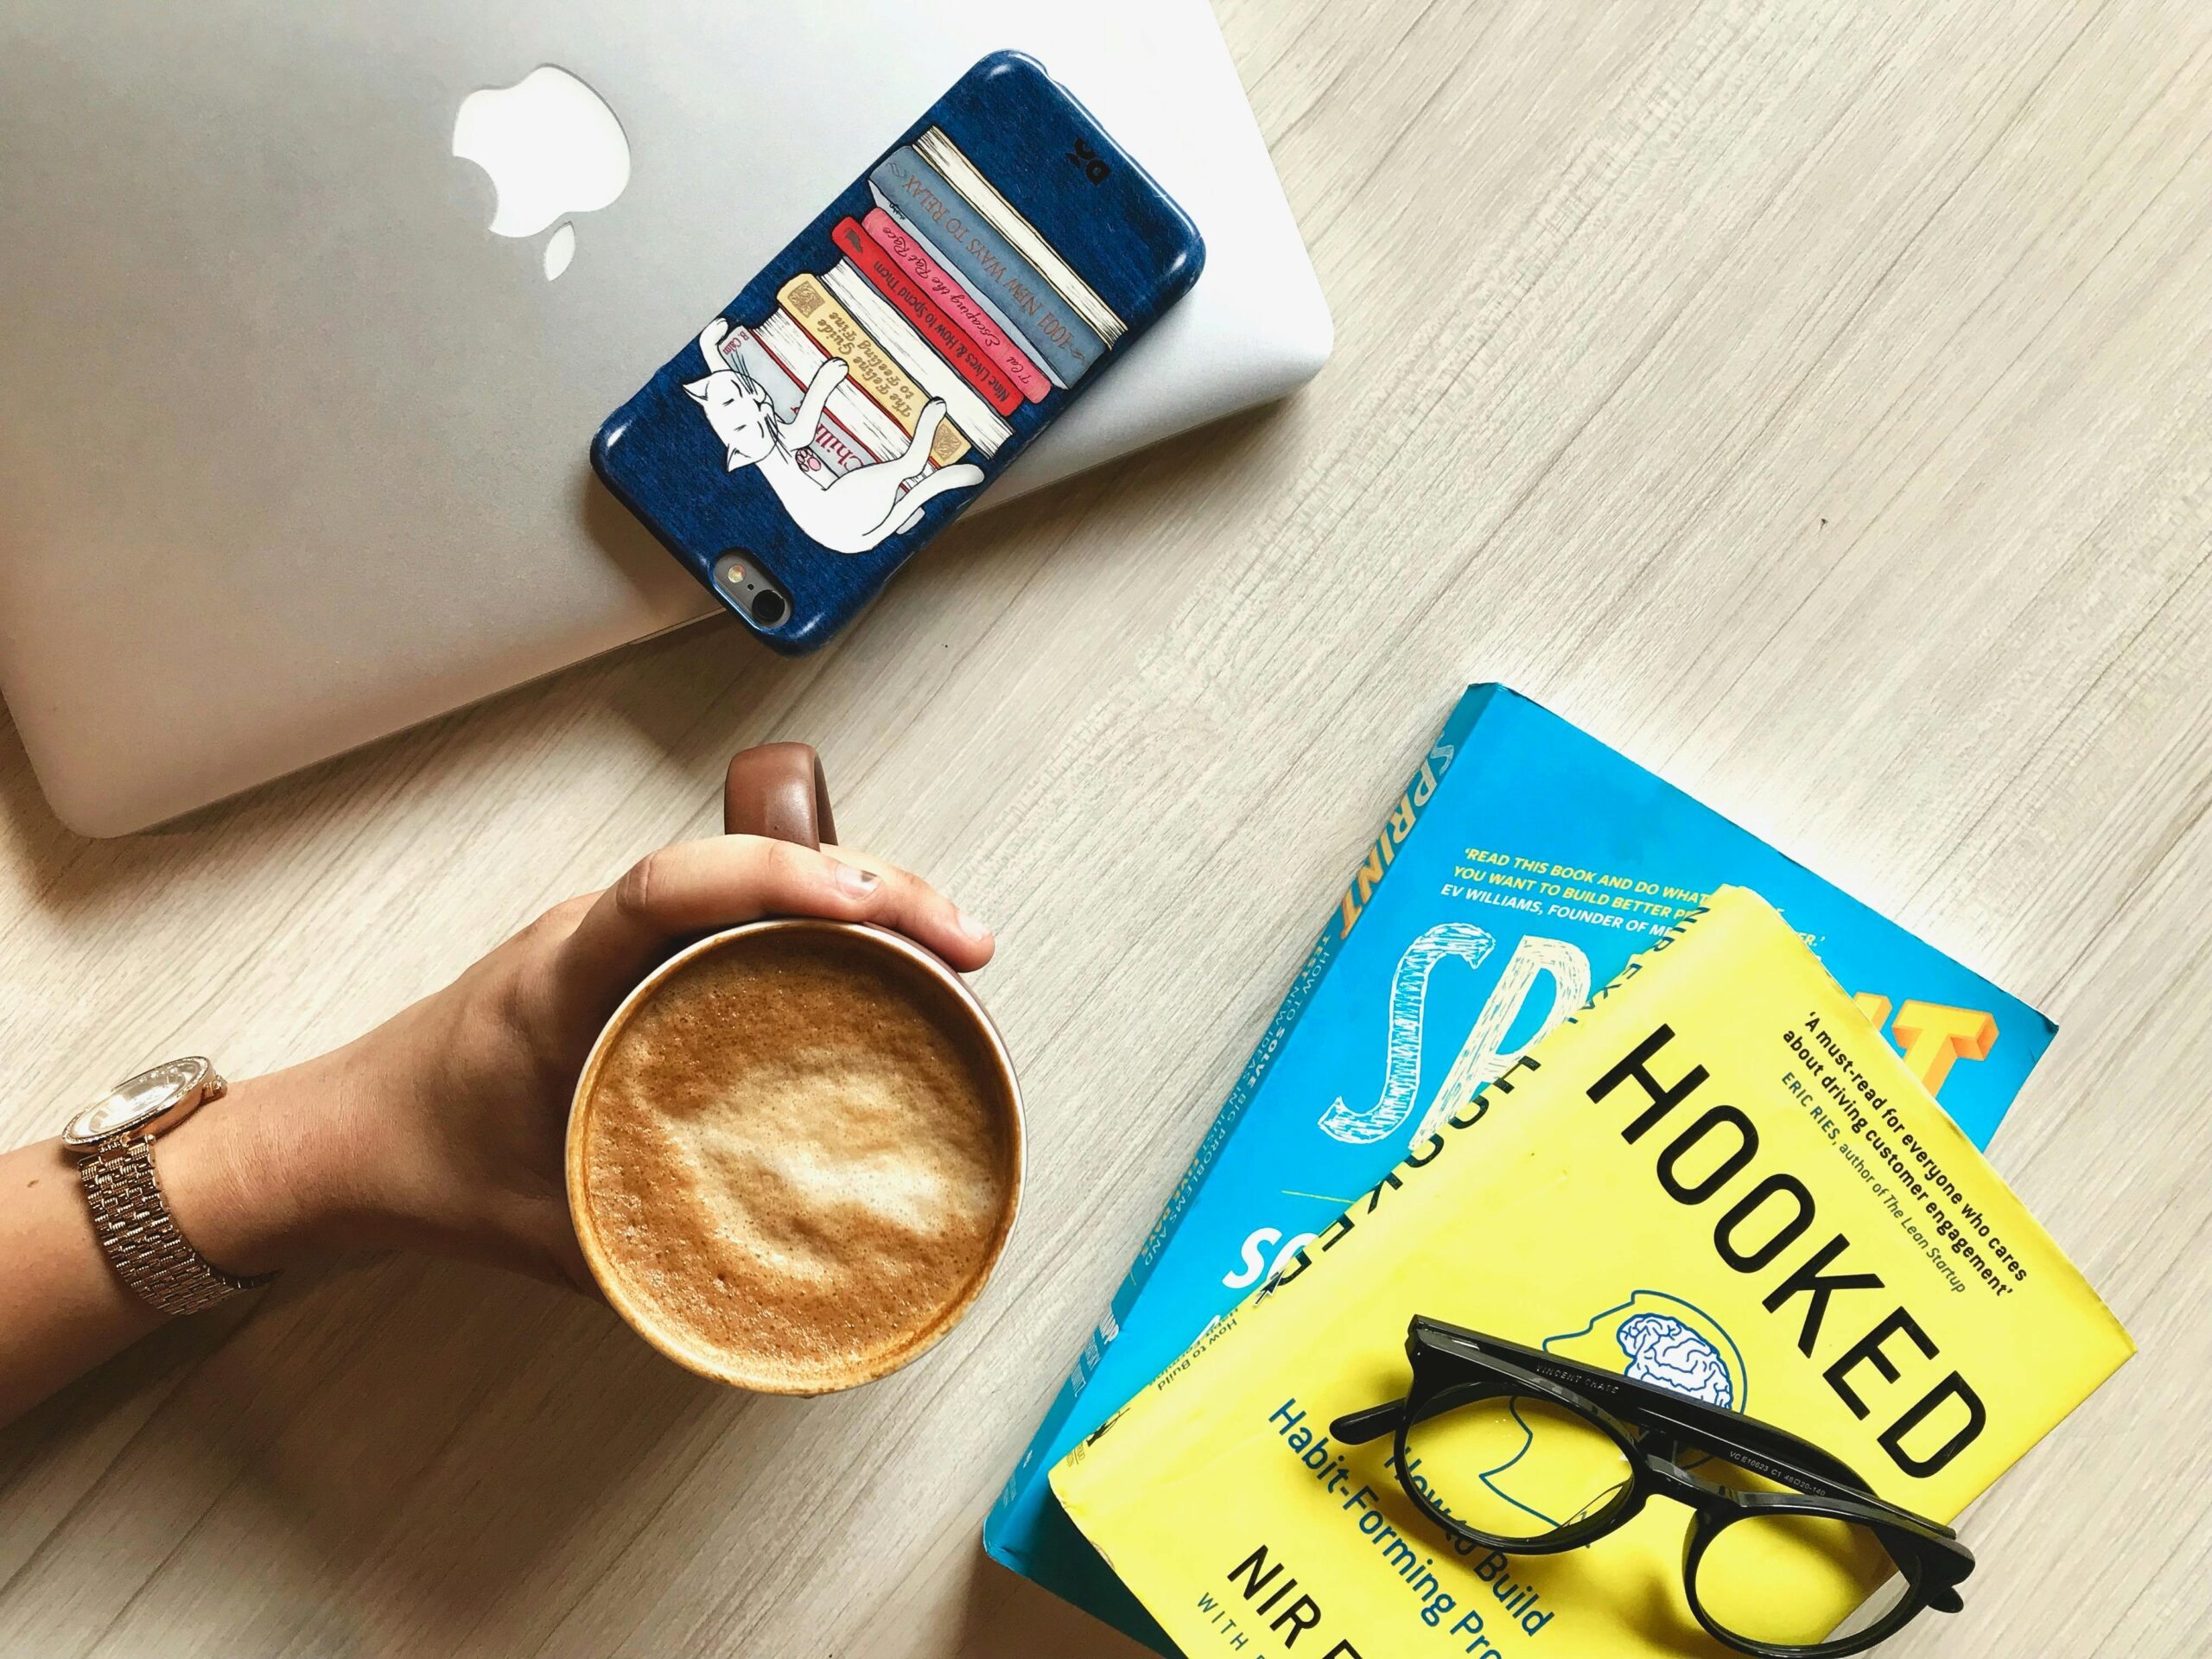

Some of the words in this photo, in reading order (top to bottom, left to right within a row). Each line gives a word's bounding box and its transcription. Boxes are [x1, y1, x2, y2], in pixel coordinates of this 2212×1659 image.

[905, 175, 950, 223] RELAX
[882, 227, 907, 257] Race
[945, 218, 969, 243] TO
[874, 260, 899, 290] Them
[907, 255, 930, 278] Rat
[966, 238, 1007, 283] WAYS
[898, 288, 925, 318] Spend
[931, 276, 950, 295] the
[1003, 277, 1043, 316] NEW
[817, 319, 852, 355] Guide
[830, 312, 858, 341] Fine
[925, 314, 938, 327] to
[935, 324, 959, 348] How
[950, 295, 1001, 346] Escaping
[1039, 311, 1075, 348] 1001
[722, 338, 741, 355] Calm
[857, 340, 900, 387] Feeling
[956, 346, 968, 357] &
[854, 357, 890, 395] Feline
[965, 354, 991, 382] Lives
[890, 393, 912, 417] The
[900, 385, 914, 400] to
[988, 378, 1010, 403] Nine
[1341, 733, 1454, 940] SPRINT
[1453, 865, 1485, 882] YOU
[1488, 873, 1536, 892] WANT
[1539, 882, 1561, 897] TO
[1562, 887, 1611, 906] BUILD
[1611, 897, 1672, 919] BETTER
[1513, 856, 1549, 874] THIS
[1550, 864, 1597, 884] BOOK
[1597, 874, 1633, 891] AND
[1634, 881, 1660, 896] DO
[1662, 886, 1710, 905] WHAT
[1440, 883, 1464, 897] EV
[1465, 888, 1543, 916] WILLIAMS,
[1547, 905, 1625, 929] FOUNDER
[1625, 918, 1649, 932] OF
[1303, 951, 1330, 995] HOW
[1275, 986, 1300, 1027] NEW
[1287, 1000, 1302, 1020] TO
[1243, 1031, 1274, 1081] IDEAS
[1247, 1027, 1286, 1090] SOLVE
[1227, 1095, 1247, 1122] BIG
[1229, 1087, 1242, 1105] IN
[1783, 1031, 1824, 1077] about
[1821, 1076, 1868, 1134] driving
[1866, 1130, 1929, 1200] customer
[1815, 1031, 1887, 1110] must-read
[1882, 1108, 1905, 1133] for
[1902, 1135, 1962, 1204] everyone
[1961, 1204, 1990, 1236] who
[1988, 1238, 2027, 1281] cares
[1169, 1129, 1226, 1223] PROBLEMS
[1782, 1072, 1813, 1107] ERIC
[1810, 1106, 1840, 1145] RIES,
[1840, 1143, 1874, 1184] author
[1872, 1183, 1889, 1197] of
[1884, 1195, 1904, 1218] The
[1901, 1217, 1929, 1249] Lean
[1926, 1248, 1966, 1293] Startup
[1144, 1226, 1167, 1266] AND
[1586, 1023, 1986, 1478] HOOKED
[1209, 1318, 1237, 1345] How
[1192, 1344, 1207, 1358] to
[1157, 1358, 1191, 1391] Build
[1537, 1366, 1582, 1382] VINCENT
[1730, 1452, 1741, 1460] VC
[1268, 1398, 1456, 1627] Habit-Forming
[1227, 1544, 1322, 1649] NIR
[1473, 1550, 1555, 1637] Build
[1197, 1592, 1249, 1651] WITH
